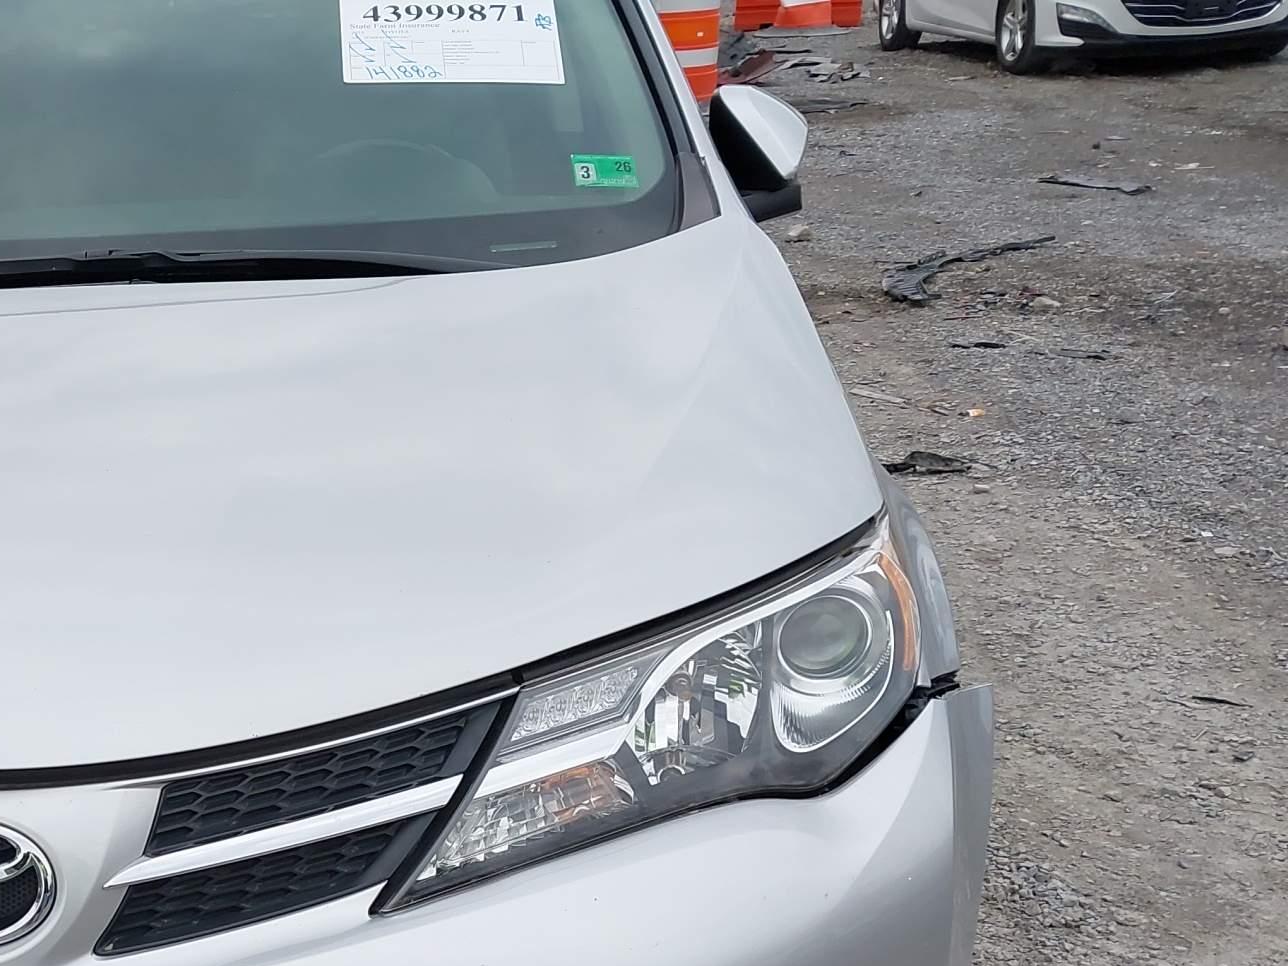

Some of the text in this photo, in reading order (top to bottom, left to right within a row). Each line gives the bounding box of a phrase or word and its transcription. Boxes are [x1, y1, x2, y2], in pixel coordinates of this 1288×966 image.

[362, 3, 529, 23] 43999871
[365, 64, 443, 80] 141882
[580, 165, 591, 179] 3
[615, 161, 632, 173] 26
